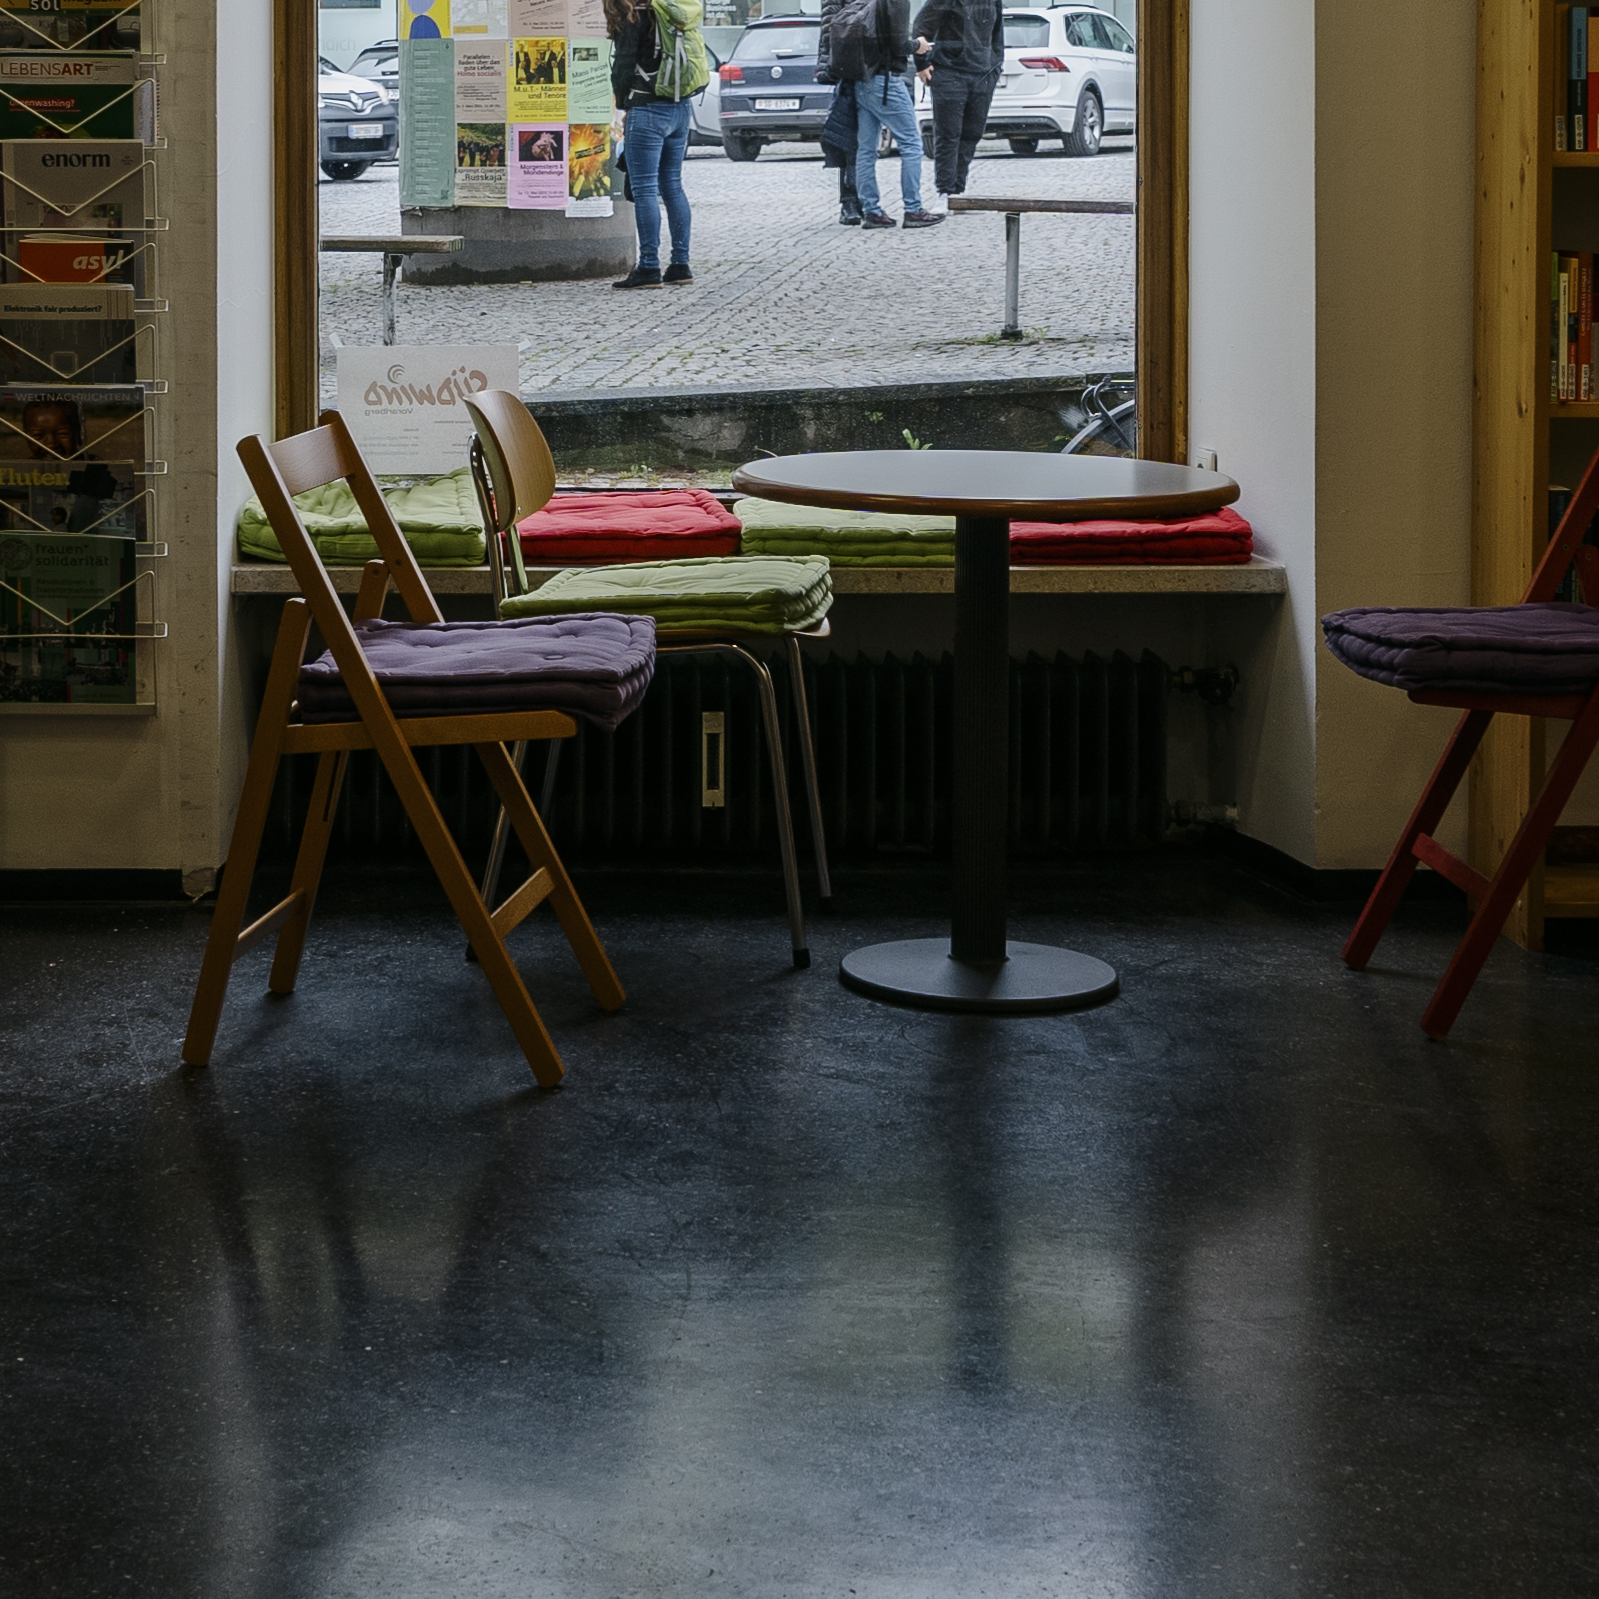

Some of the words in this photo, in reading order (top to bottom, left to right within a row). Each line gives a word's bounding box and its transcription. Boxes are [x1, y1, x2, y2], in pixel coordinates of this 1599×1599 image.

[1, 62, 93, 76] LEBENSART
[41, 153, 111, 167] enorm
[72, 250, 124, 275] asyl
[59, 305, 102, 314] produziert?
[15, 392, 131, 401] WELTNACHRICHTEN
[35, 555, 109, 567] solidarität
